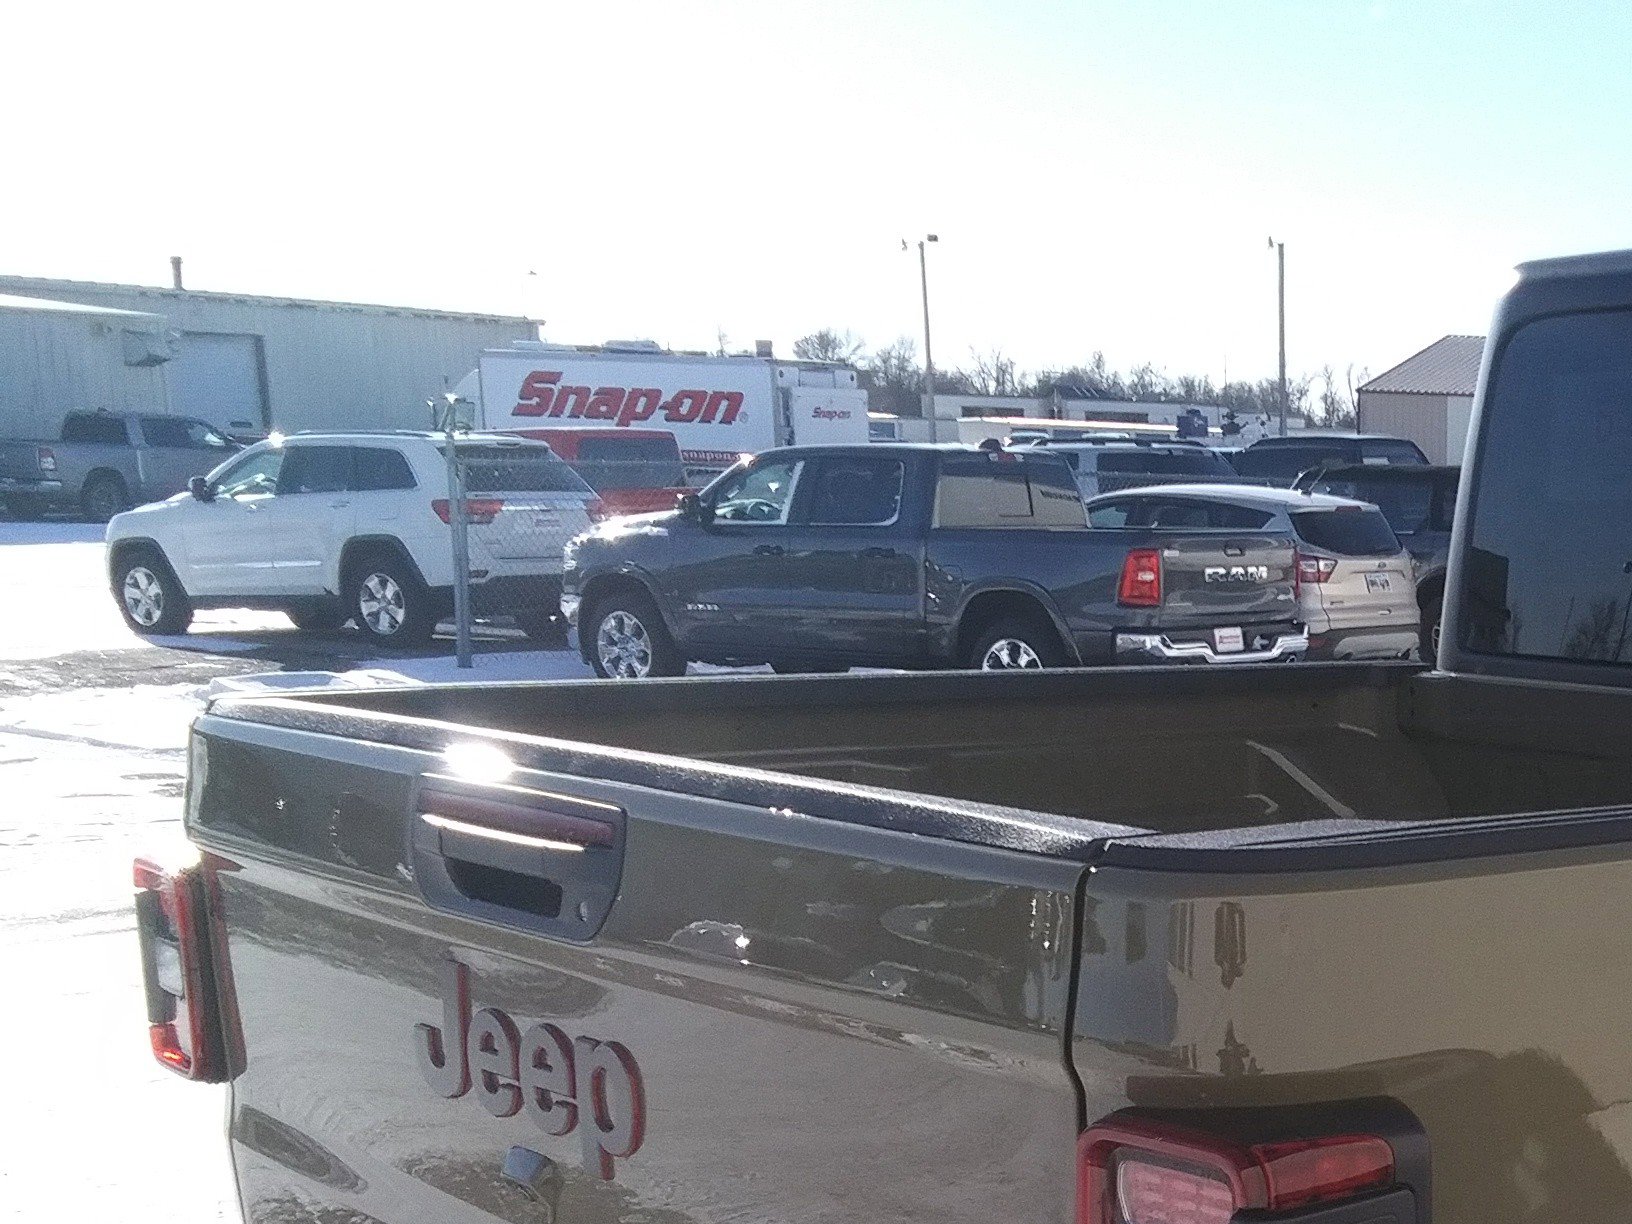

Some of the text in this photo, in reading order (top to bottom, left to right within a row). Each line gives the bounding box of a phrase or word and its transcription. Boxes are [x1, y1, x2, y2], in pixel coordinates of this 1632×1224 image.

[511, 371, 745, 427] Snap-on
[811, 406, 851, 421] Snap-on
[1204, 566, 1268, 583] RAM
[412, 957, 648, 1181] Jeep
